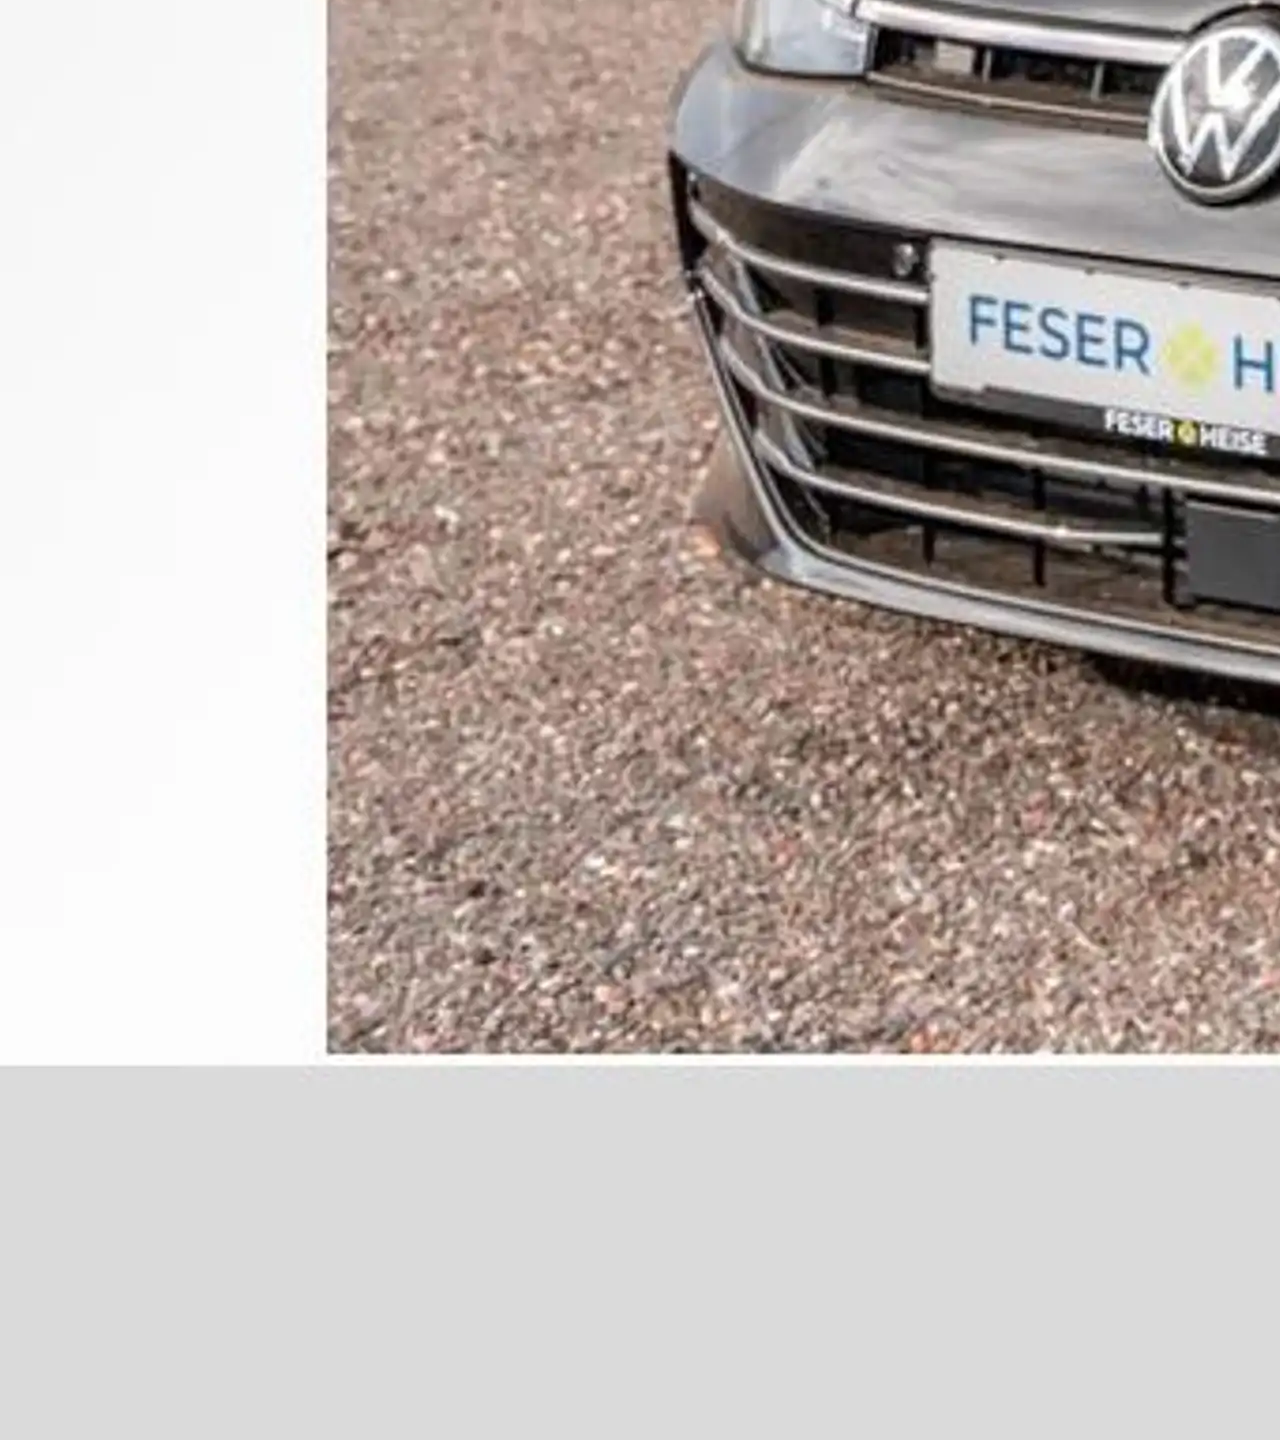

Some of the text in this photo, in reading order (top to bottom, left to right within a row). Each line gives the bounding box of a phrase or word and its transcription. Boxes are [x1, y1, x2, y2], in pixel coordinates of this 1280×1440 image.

[966, 294, 1153, 375] FESER
[1104, 408, 1268, 456] FESER HEISE
